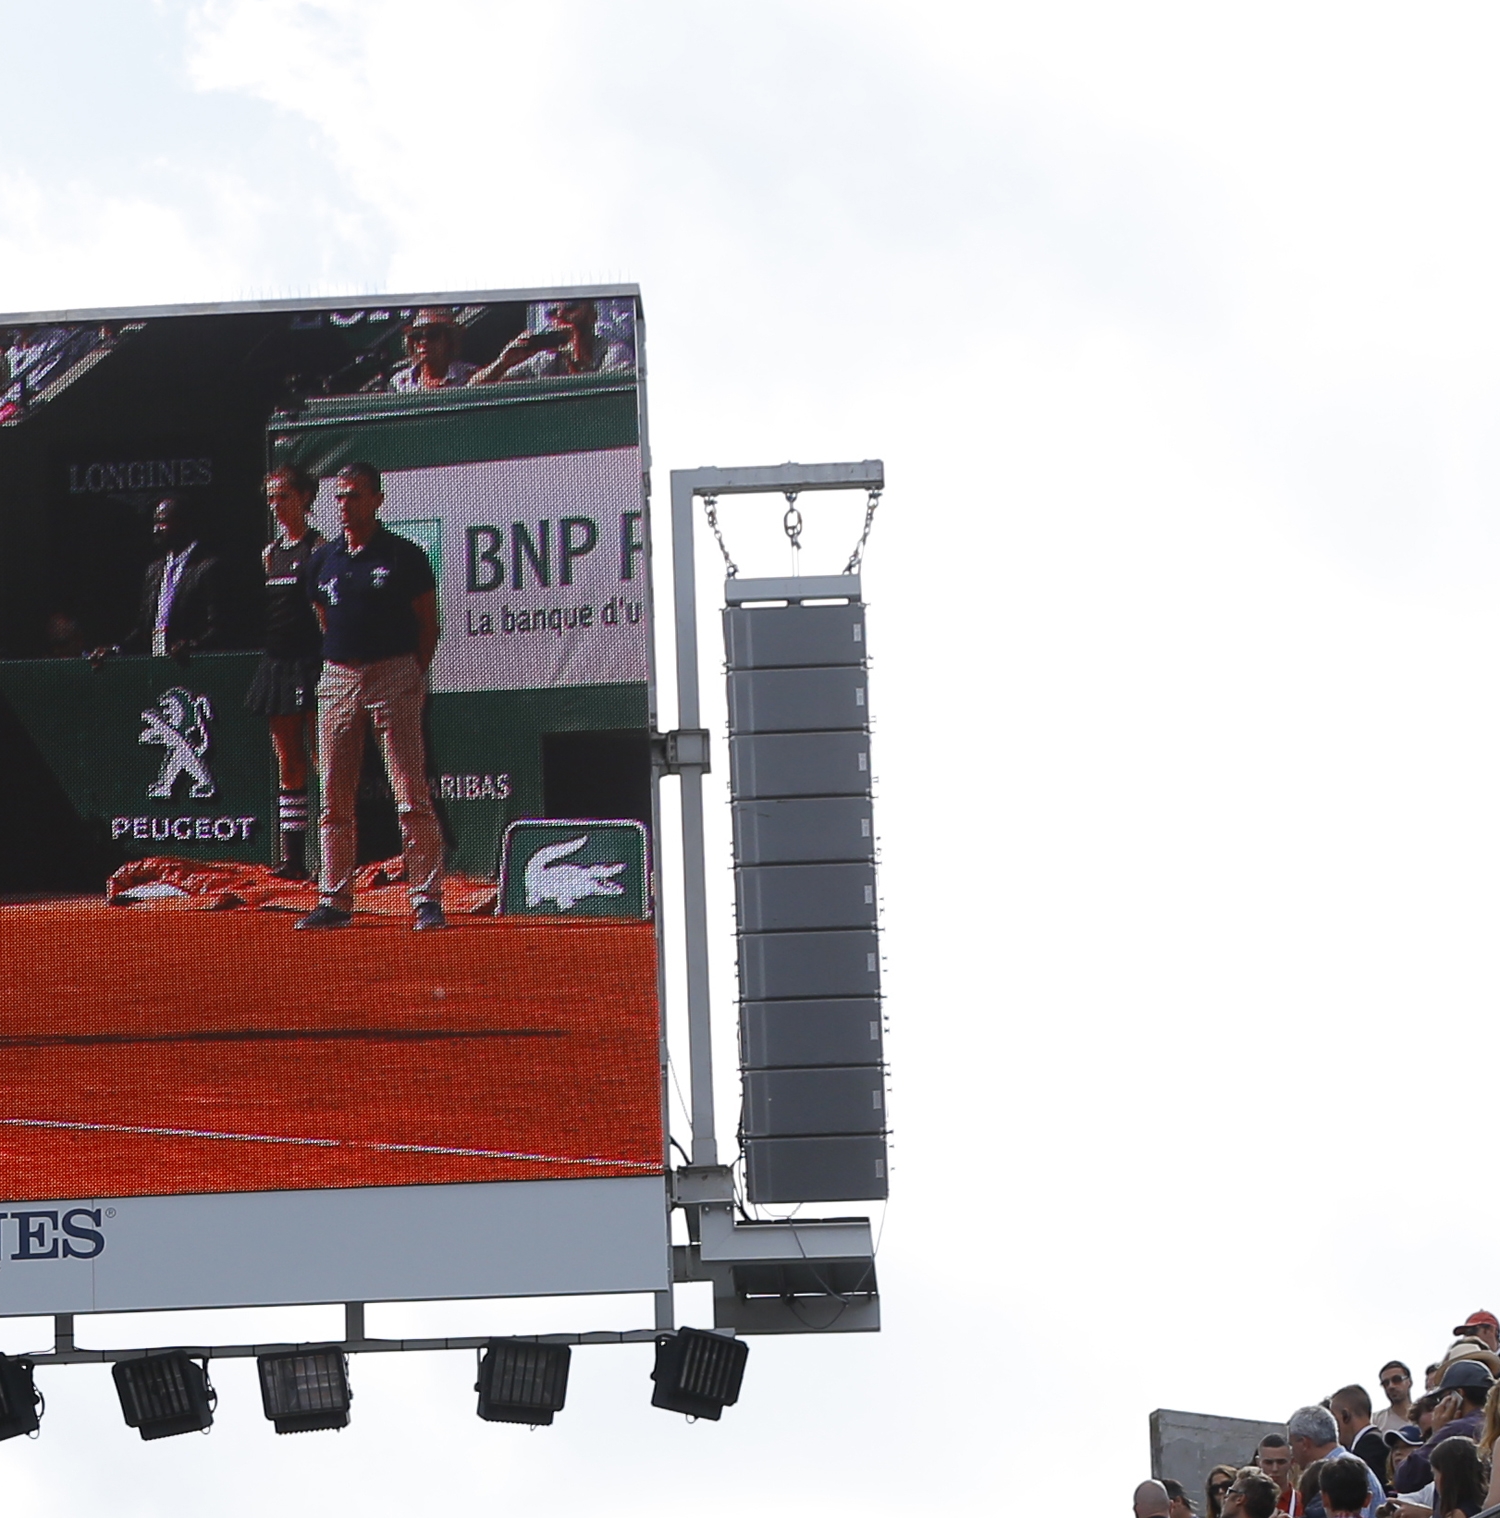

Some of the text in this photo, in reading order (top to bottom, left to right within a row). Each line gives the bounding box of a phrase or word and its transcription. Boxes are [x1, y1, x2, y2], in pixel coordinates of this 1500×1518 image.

[69, 457, 213, 494] LONGINES
[464, 512, 599, 593] BNP
[467, 608, 494, 638] La
[501, 605, 594, 637] banque
[111, 814, 258, 842] PEUGEOT
